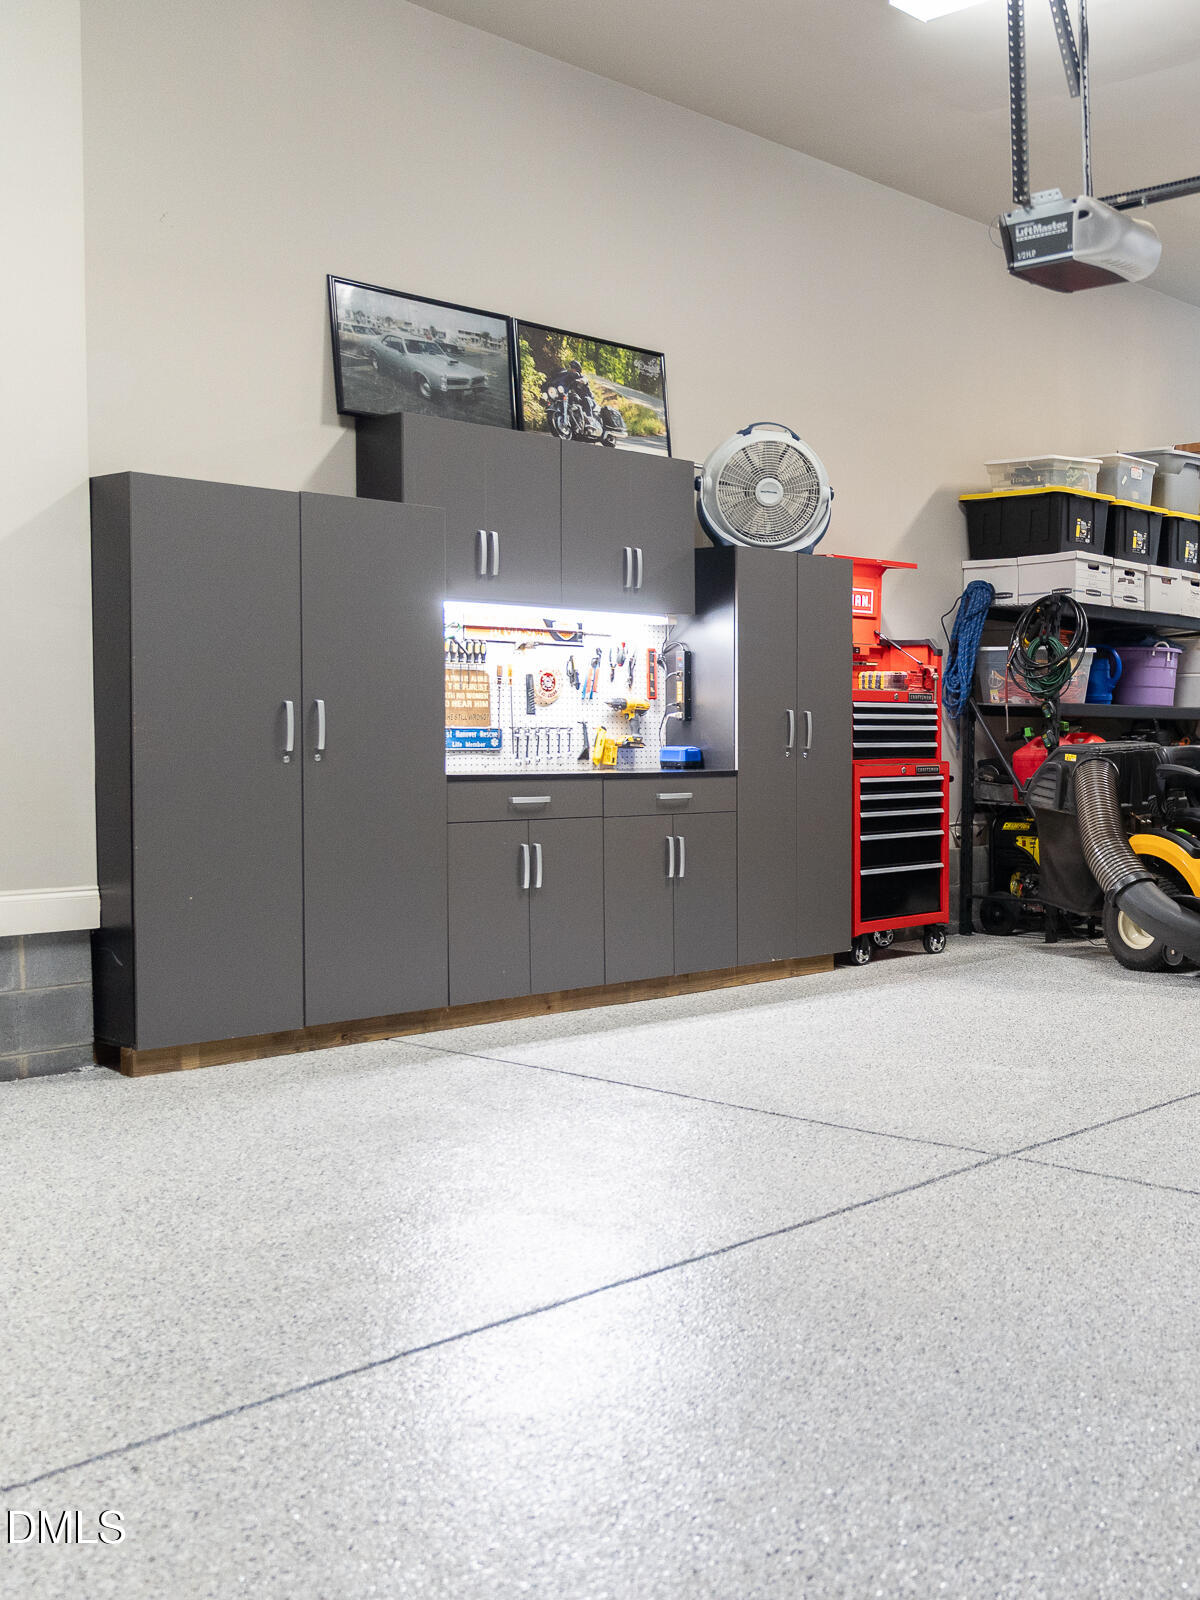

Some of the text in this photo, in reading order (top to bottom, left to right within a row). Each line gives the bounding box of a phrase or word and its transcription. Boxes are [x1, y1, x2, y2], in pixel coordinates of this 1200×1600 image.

[1015, 221, 1068, 237] LiftMaster
[451, 700, 473, 708] HEAR
[474, 700, 489, 708] HIM
[455, 730, 477, 738] Hanover
[479, 730, 499, 738] Rescue
